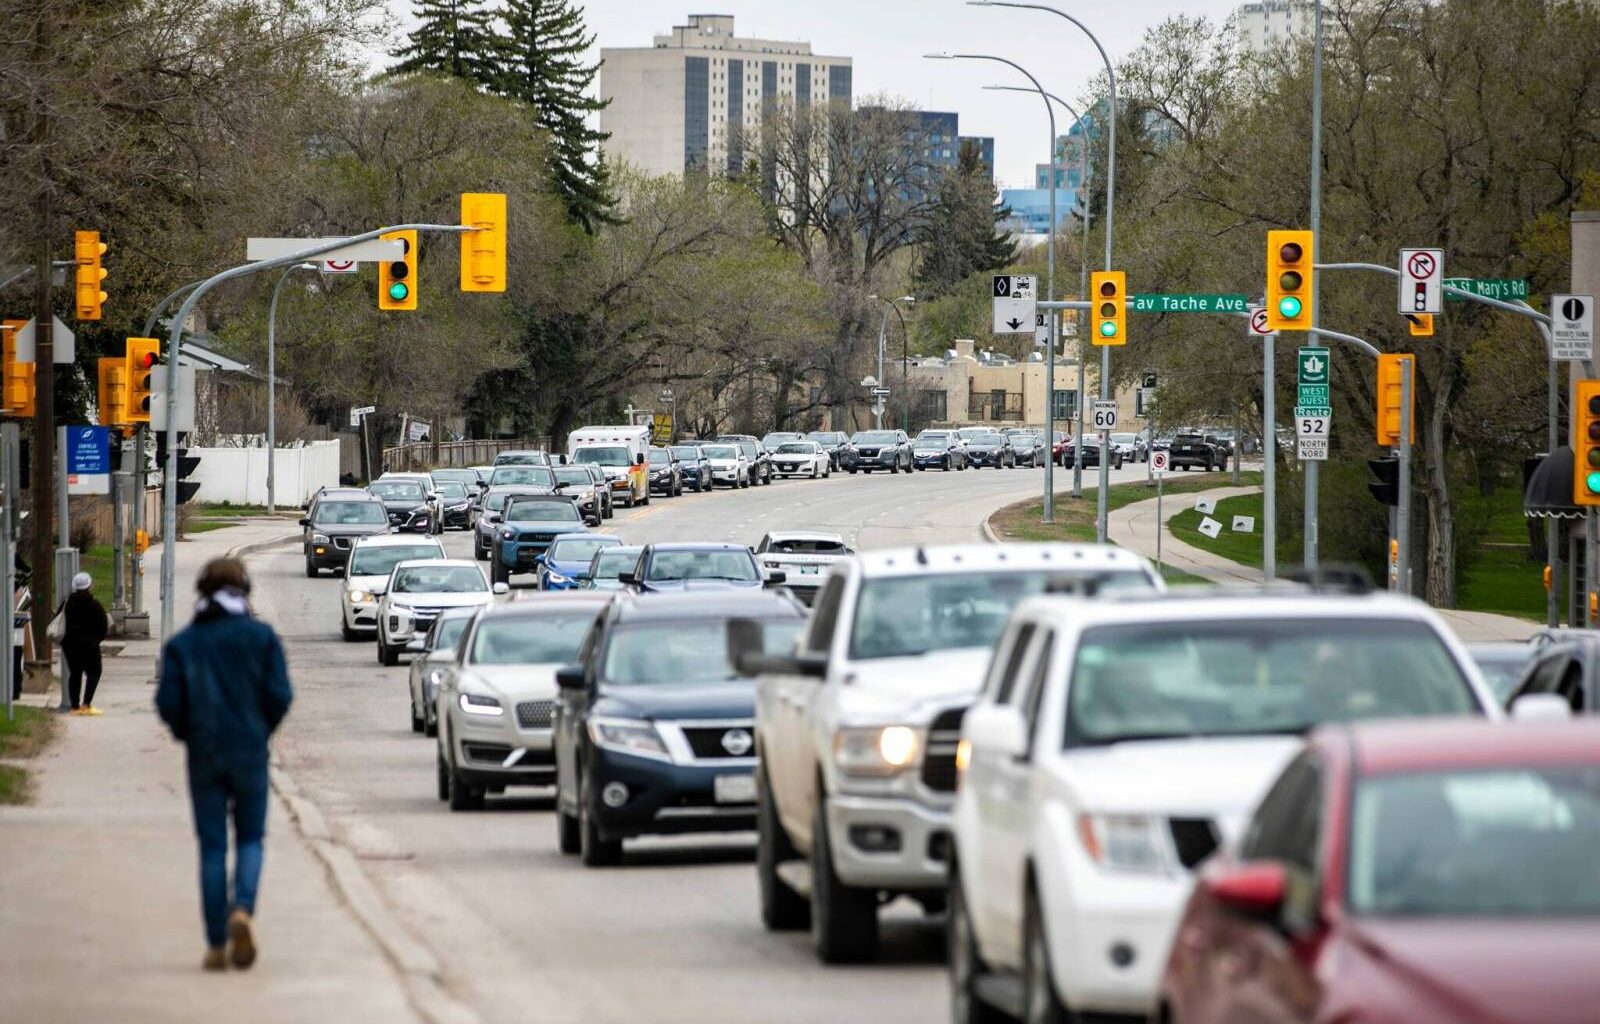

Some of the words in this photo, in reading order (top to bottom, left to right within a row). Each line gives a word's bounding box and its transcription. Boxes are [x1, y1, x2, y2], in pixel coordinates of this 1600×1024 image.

[1460, 281, 1470, 292] St
[1477, 280, 1509, 299] Mary's
[1512, 280, 1525, 296] Rd
[1136, 298, 1154, 310] av
[1162, 296, 1208, 310] Tache
[1215, 296, 1244, 310] Ave
[1302, 387, 1325, 395] WEST
[1299, 397, 1328, 405] OUEST
[1298, 408, 1329, 416] Route
[1095, 411, 1115, 426] 60
[1303, 419, 1323, 434] 52
[1300, 440, 1327, 448] NORTH
[1301, 450, 1324, 458] NORD
